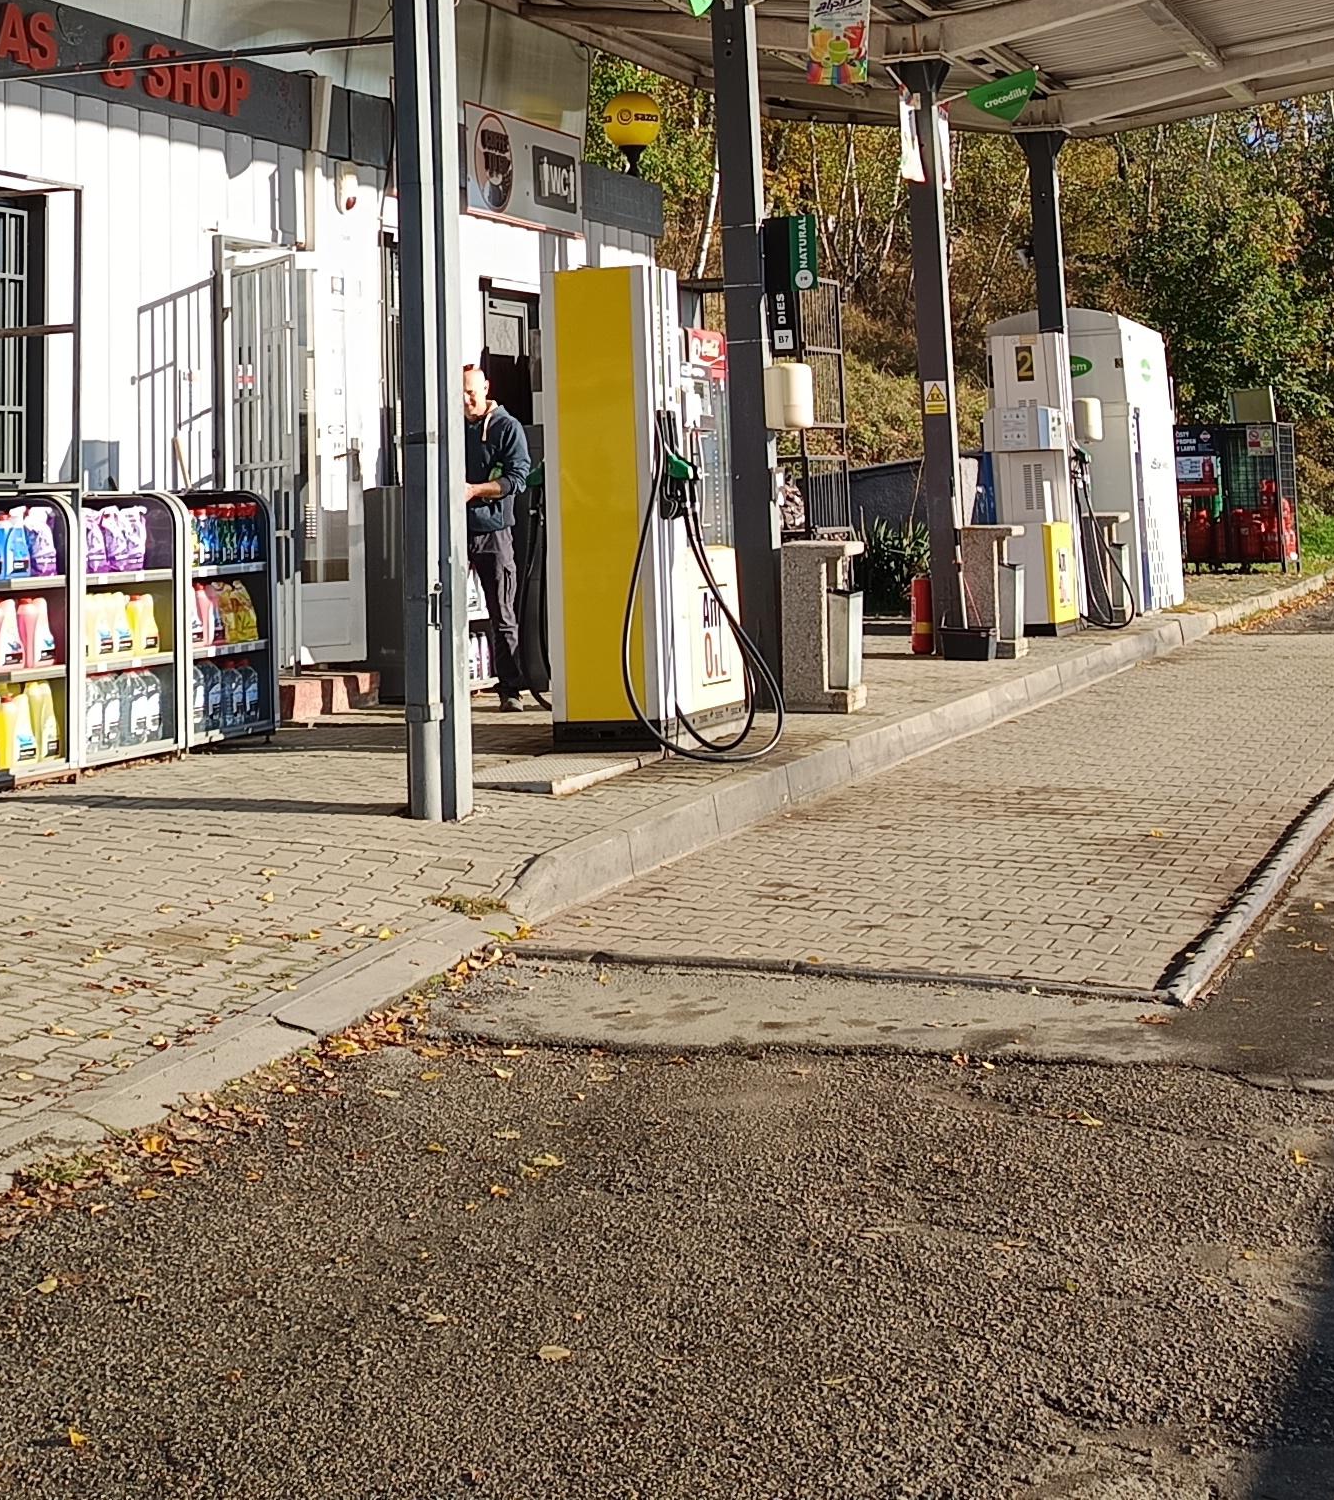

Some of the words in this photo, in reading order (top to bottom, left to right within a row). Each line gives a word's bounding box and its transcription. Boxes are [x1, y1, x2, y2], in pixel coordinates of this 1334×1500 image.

[142, 43, 251, 117] SHOP
[984, 88, 1027, 108] crocodille
[550, 165, 569, 197] WC
[798, 216, 808, 268] NATURAL
[1017, 351, 1033, 377] 2
